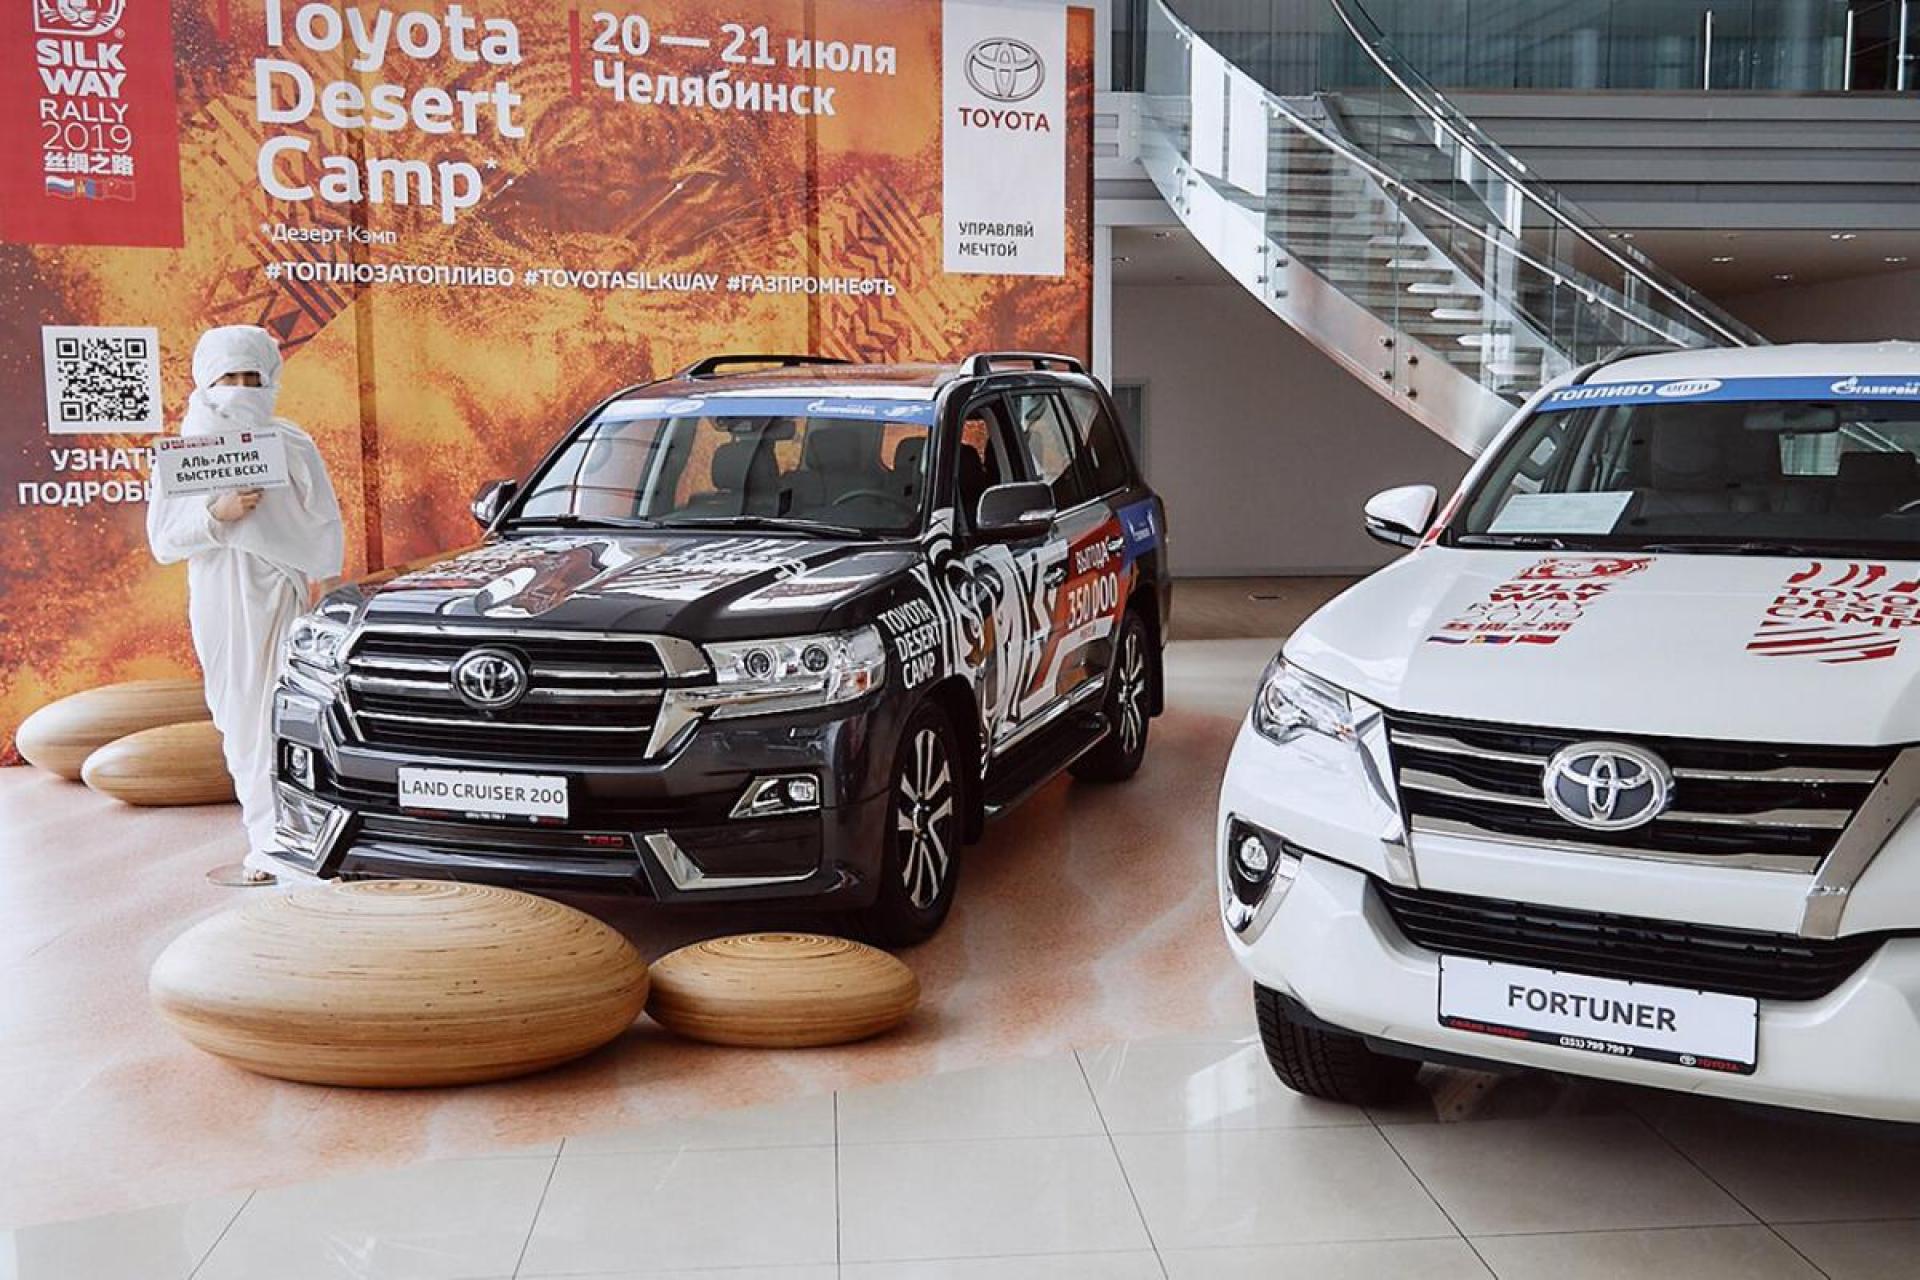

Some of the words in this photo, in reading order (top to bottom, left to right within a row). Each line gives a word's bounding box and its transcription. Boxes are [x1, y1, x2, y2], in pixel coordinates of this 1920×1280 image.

[36, 39, 126, 70] SILK
[592, 12, 650, 55] 20
[720, 23, 776, 65] 21
[786, 38, 897, 75] июля
[38, 67, 127, 98] WAY
[592, 59, 836, 116] Челябинск
[40, 99, 129, 123] RALLY
[255, 58, 525, 139] Desert
[958, 107, 1050, 132] TOYOTA
[42, 121, 132, 153] 2019
[348, 227, 396, 244] Кэмп
[958, 221, 1034, 237] УПРАВЛЯЙ
[958, 241, 1017, 257] МЕЧТОЙ
[265, 262, 514, 286] #ТОПЛЮЗАТОПЛИВО
[525, 268, 719, 291] #TOYOTASILKWAY
[727, 274, 896, 296] #ГАЗПРОМНЕФТЬ
[1550, 384, 1654, 402] ТОПЛИВО
[176, 467, 232, 482] БЫСТРЕЕ
[234, 464, 268, 476] ВСЕХ!
[181, 450, 260, 469] АЛЬ-АТТИЯ
[877, 598, 938, 635] TOYOTA
[895, 620, 942, 662] DESERT
[903, 652, 936, 689] CAMP
[401, 780, 449, 796] LAND
[452, 783, 526, 801] CRUISER
[530, 789, 564, 803] 200
[1508, 984, 1677, 1032] FORTUNER
